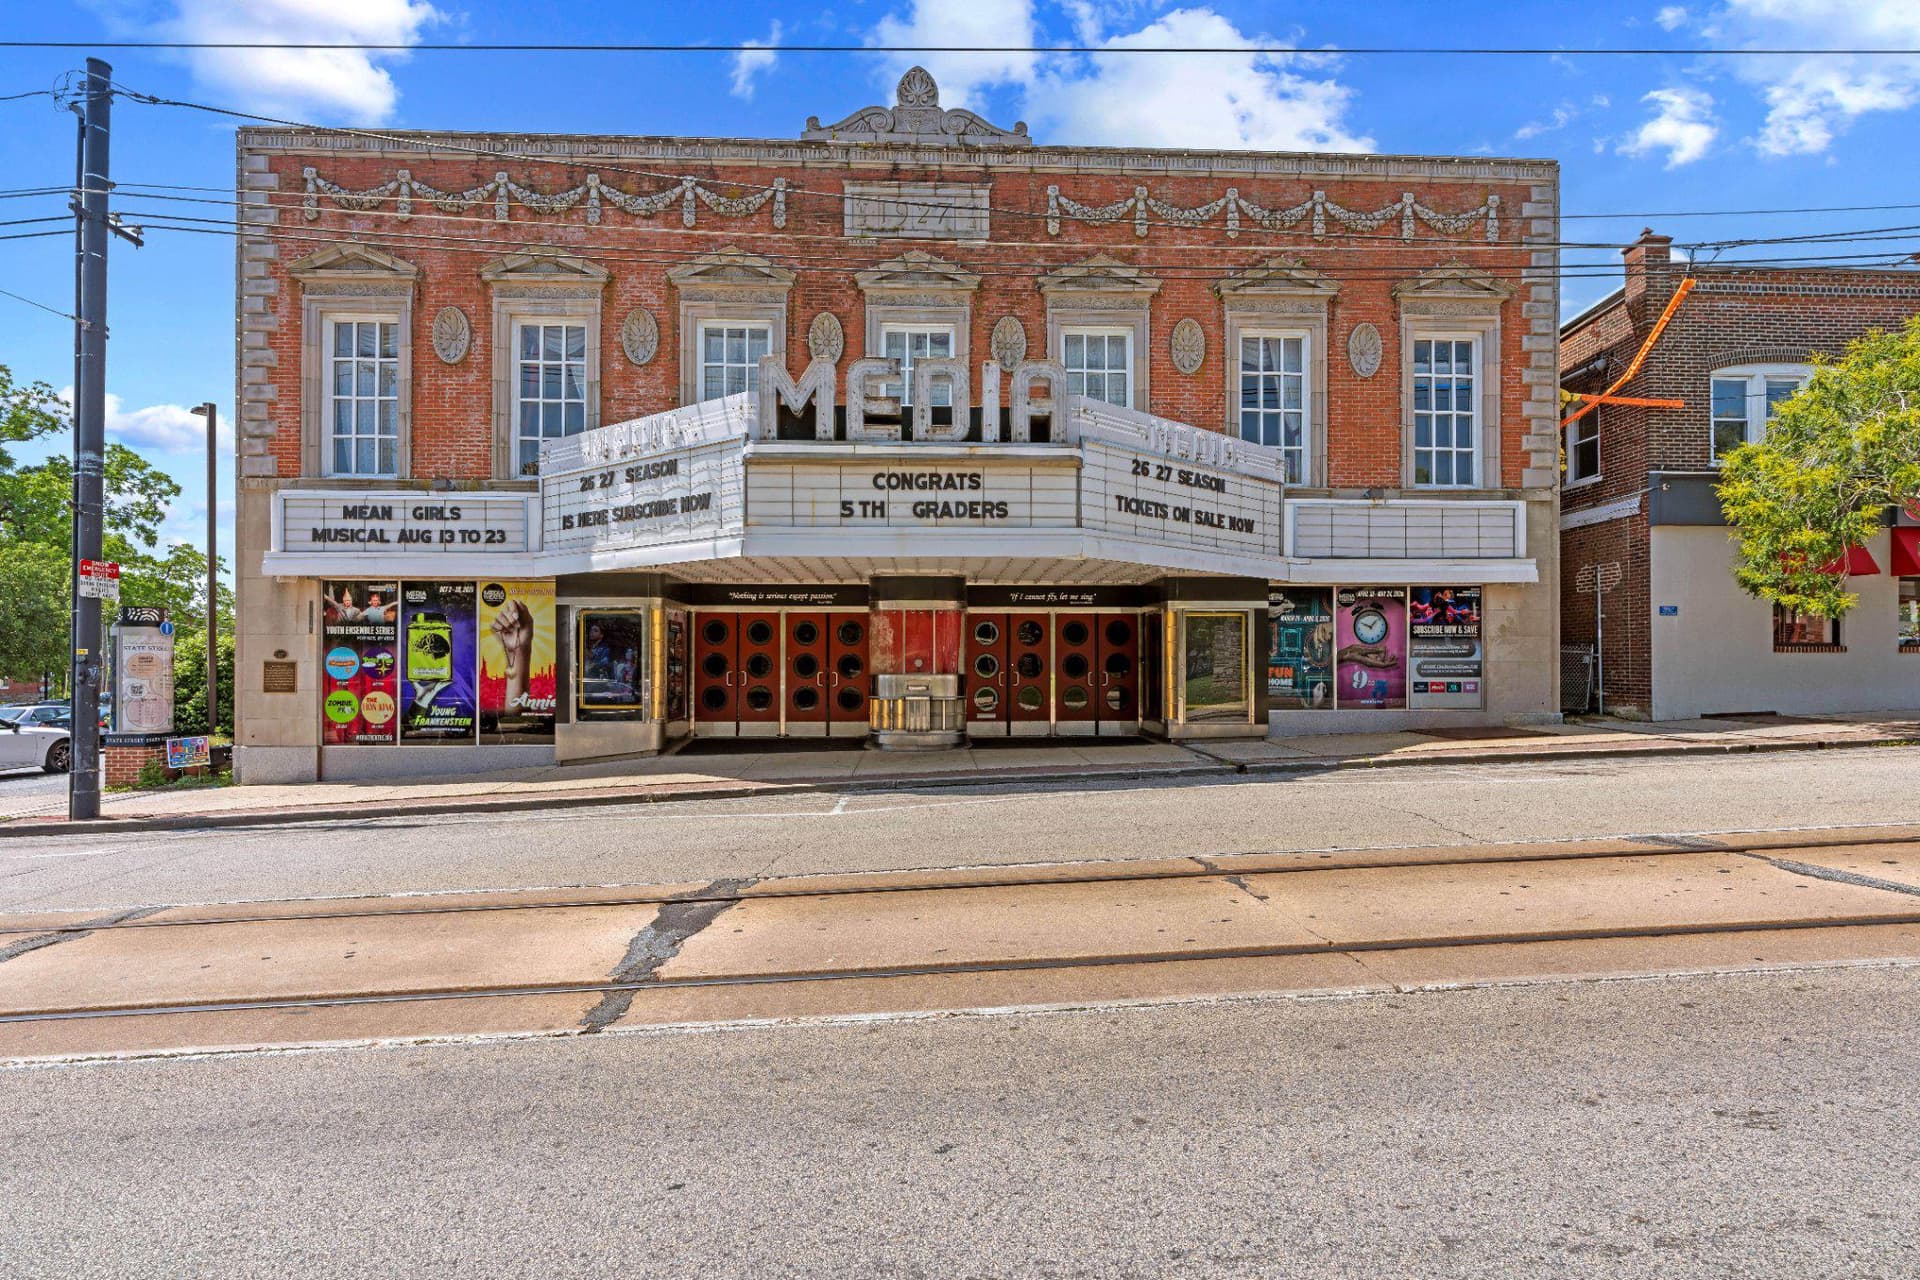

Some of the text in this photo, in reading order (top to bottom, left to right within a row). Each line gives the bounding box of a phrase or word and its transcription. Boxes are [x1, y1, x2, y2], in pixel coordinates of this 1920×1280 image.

[758, 354, 1069, 443] MEDIA
[599, 470, 615, 489] 27
[625, 458, 679, 484] SEASON
[872, 472, 982, 491] CONGRATS
[1131, 459, 1227, 494] 26 27 SEASON
[341, 505, 462, 521] MEAN GIRLS
[562, 492, 713, 530] IS HERE SUBSCRIBE NOW
[911, 500, 1010, 519] GRADERS
[1115, 495, 1256, 534] TICKETS ON SALE NOW
[311, 528, 507, 544] MUSICAL AUG 13 TO 23
[82, 565, 117, 573] EMERGENCY
[326, 625, 395, 635] YOUTH ENSEMBLE SERIES
[1413, 624, 1443, 635] SUBSCRIBE
[1444, 624, 1457, 635] NOW
[1463, 624, 1478, 635] SAVE
[1268, 666, 1294, 678] FUN
[1352, 670, 1368, 689] 9
[1268, 678, 1294, 687] HOME
[328, 699, 353, 707] ZOMBIE
[510, 691, 557, 711] Annie
[430, 704, 457, 716] YOUNG
[414, 714, 473, 727] FRANKENSTEIN
